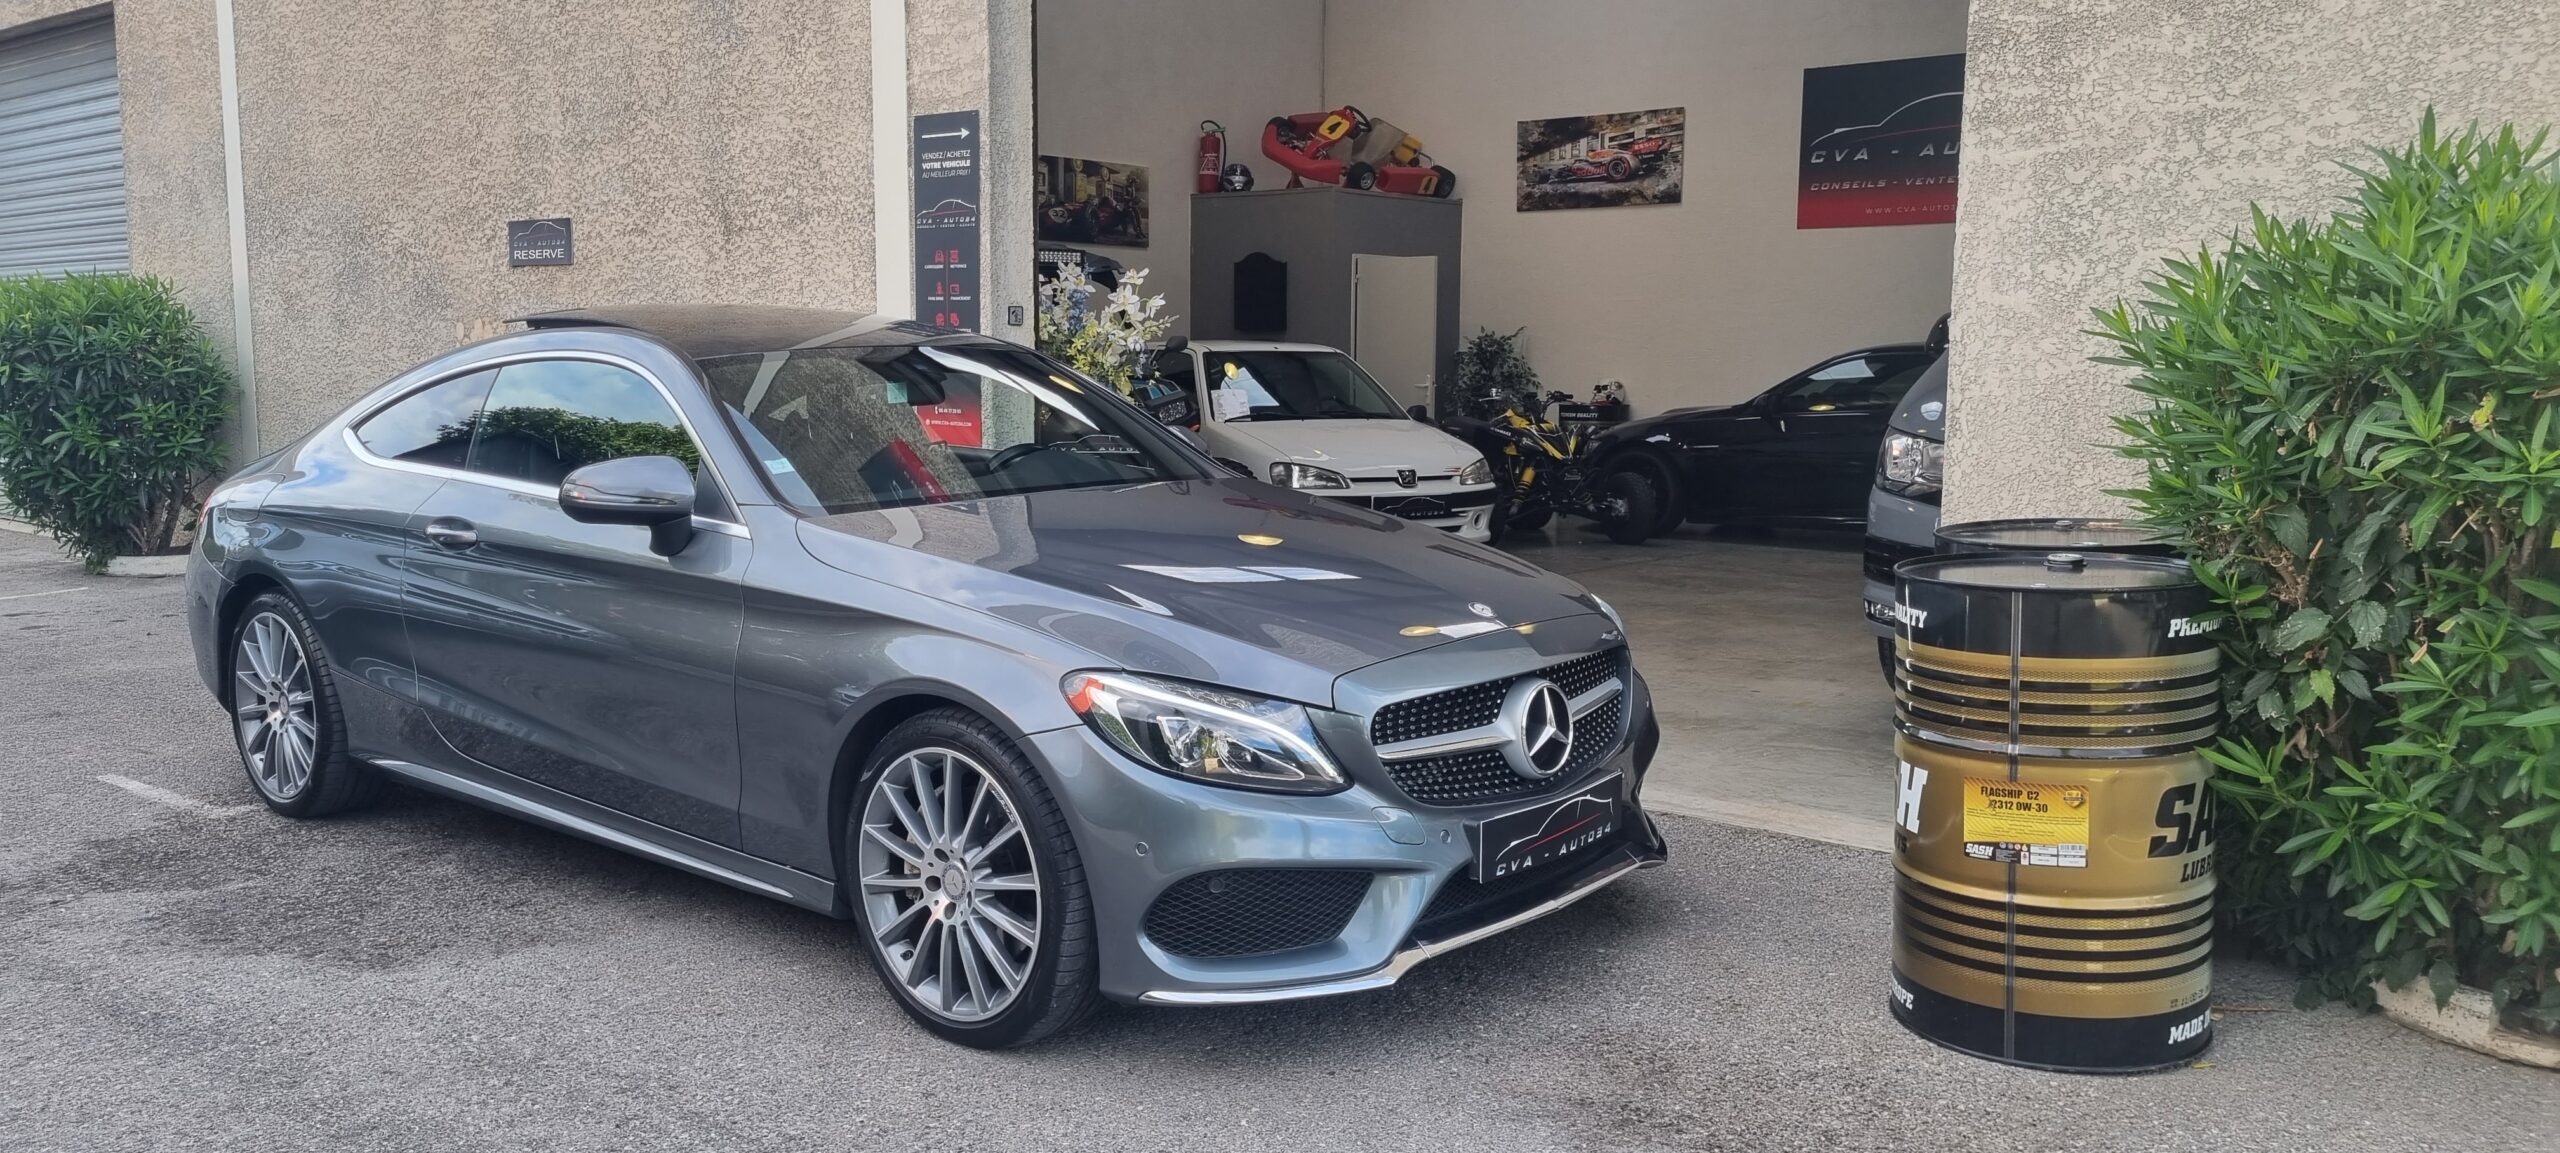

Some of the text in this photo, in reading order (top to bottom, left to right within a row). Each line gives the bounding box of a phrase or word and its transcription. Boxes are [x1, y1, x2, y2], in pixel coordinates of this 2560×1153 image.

[1328, 121, 1343, 134] 4
[1810, 147, 1868, 164] CVA
[922, 160, 971, 169] VOTRE VEHICULE
[931, 169, 956, 178] MEILLEUR
[1810, 179, 1888, 191] CONSEILS
[1051, 209, 1066, 218] 32
[514, 248, 565, 260] RESERVE
[1980, 786, 2040, 801] FLAGSHIP C2
[2016, 801, 2049, 813] 0W-30
[1965, 843, 1994, 857] SASH
[1496, 856, 1533, 876] CVA
[2168, 1014, 2204, 1044] MADE
